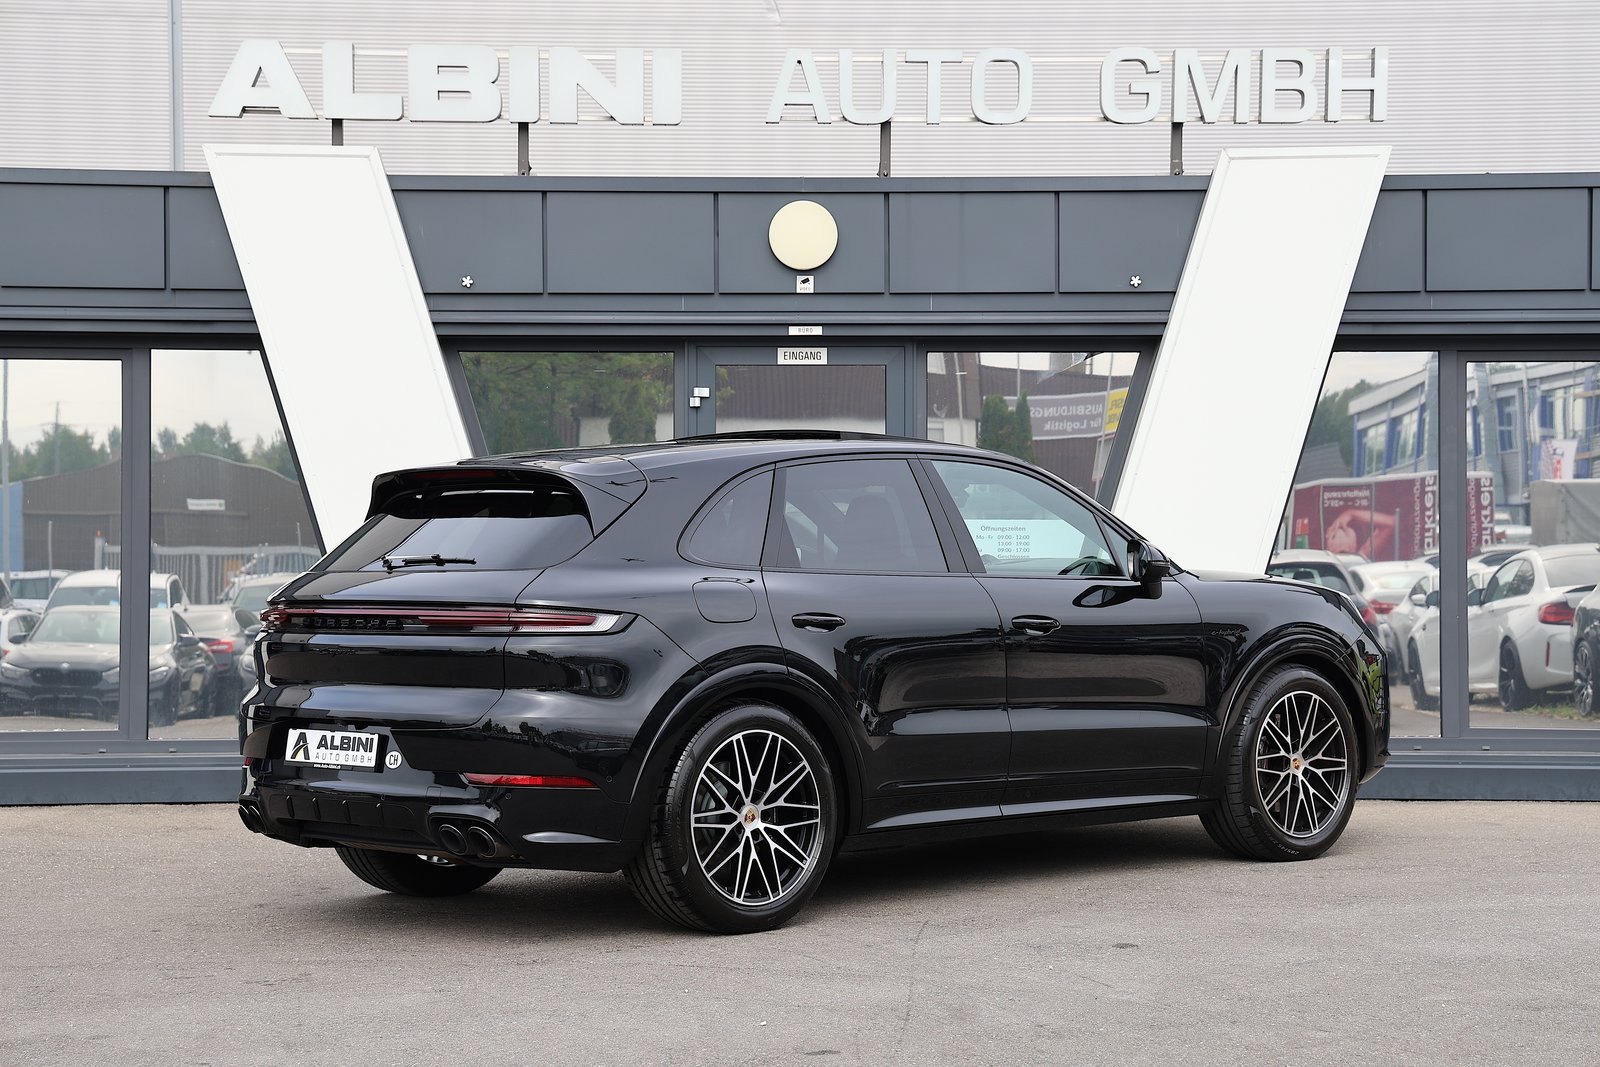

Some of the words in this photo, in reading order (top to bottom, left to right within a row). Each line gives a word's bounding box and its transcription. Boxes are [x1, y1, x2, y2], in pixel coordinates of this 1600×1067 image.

[209, 39, 682, 125] ALBINI
[766, 47, 1034, 125] AUTO
[1100, 46, 1390, 125] GMBH
[783, 351, 822, 360] EINGANG
[316, 734, 374, 753] ALBINI
[315, 751, 340, 762] AUTO
[344, 753, 373, 764] GMBH
[388, 754, 399, 766] CH
